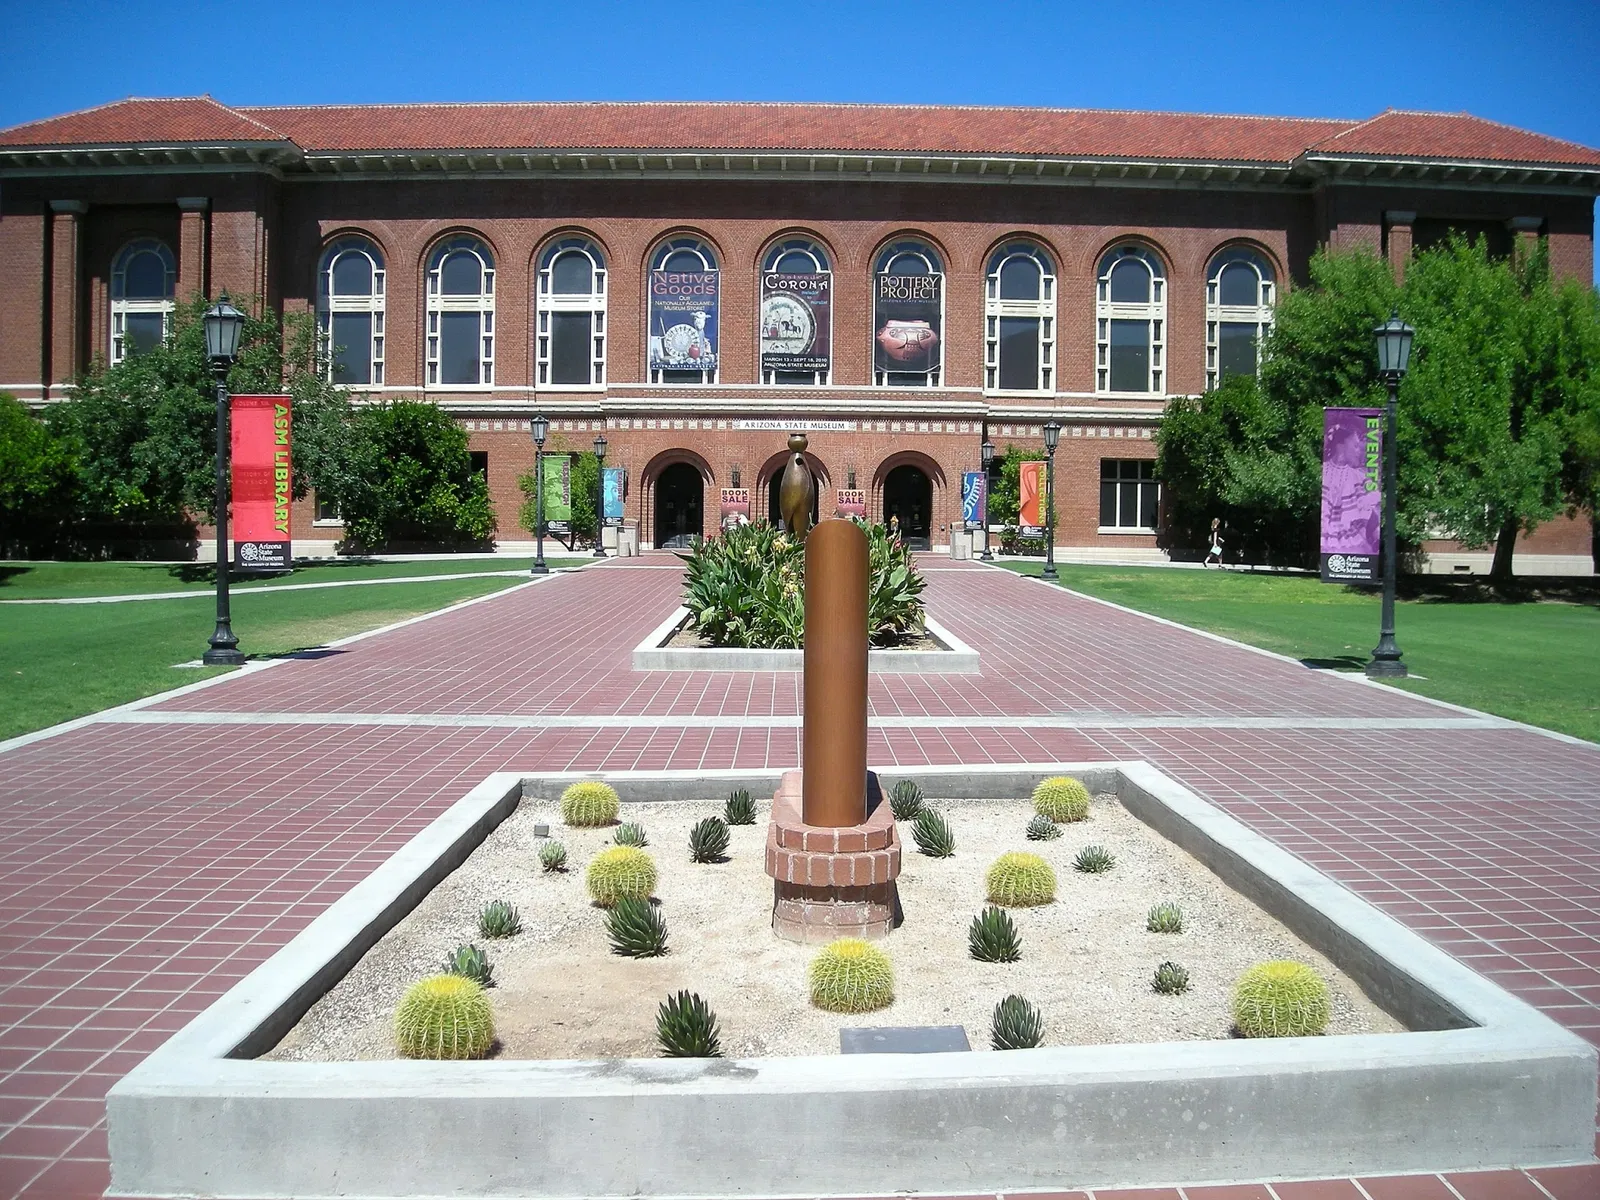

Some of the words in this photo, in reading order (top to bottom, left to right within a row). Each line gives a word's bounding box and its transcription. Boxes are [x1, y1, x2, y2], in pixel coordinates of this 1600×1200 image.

[654, 271, 715, 284] Native
[765, 274, 828, 290] CORONA
[880, 276, 940, 288] POTTERY
[653, 282, 716, 295] Goods
[880, 287, 938, 300] PROJECT
[274, 403, 289, 445] ASM
[744, 421, 782, 429] ARIZONA
[784, 421, 808, 429] STATE
[810, 422, 846, 430] MUSEUM
[1365, 418, 1379, 491] EVENTS
[274, 451, 289, 534] LIBRARY
